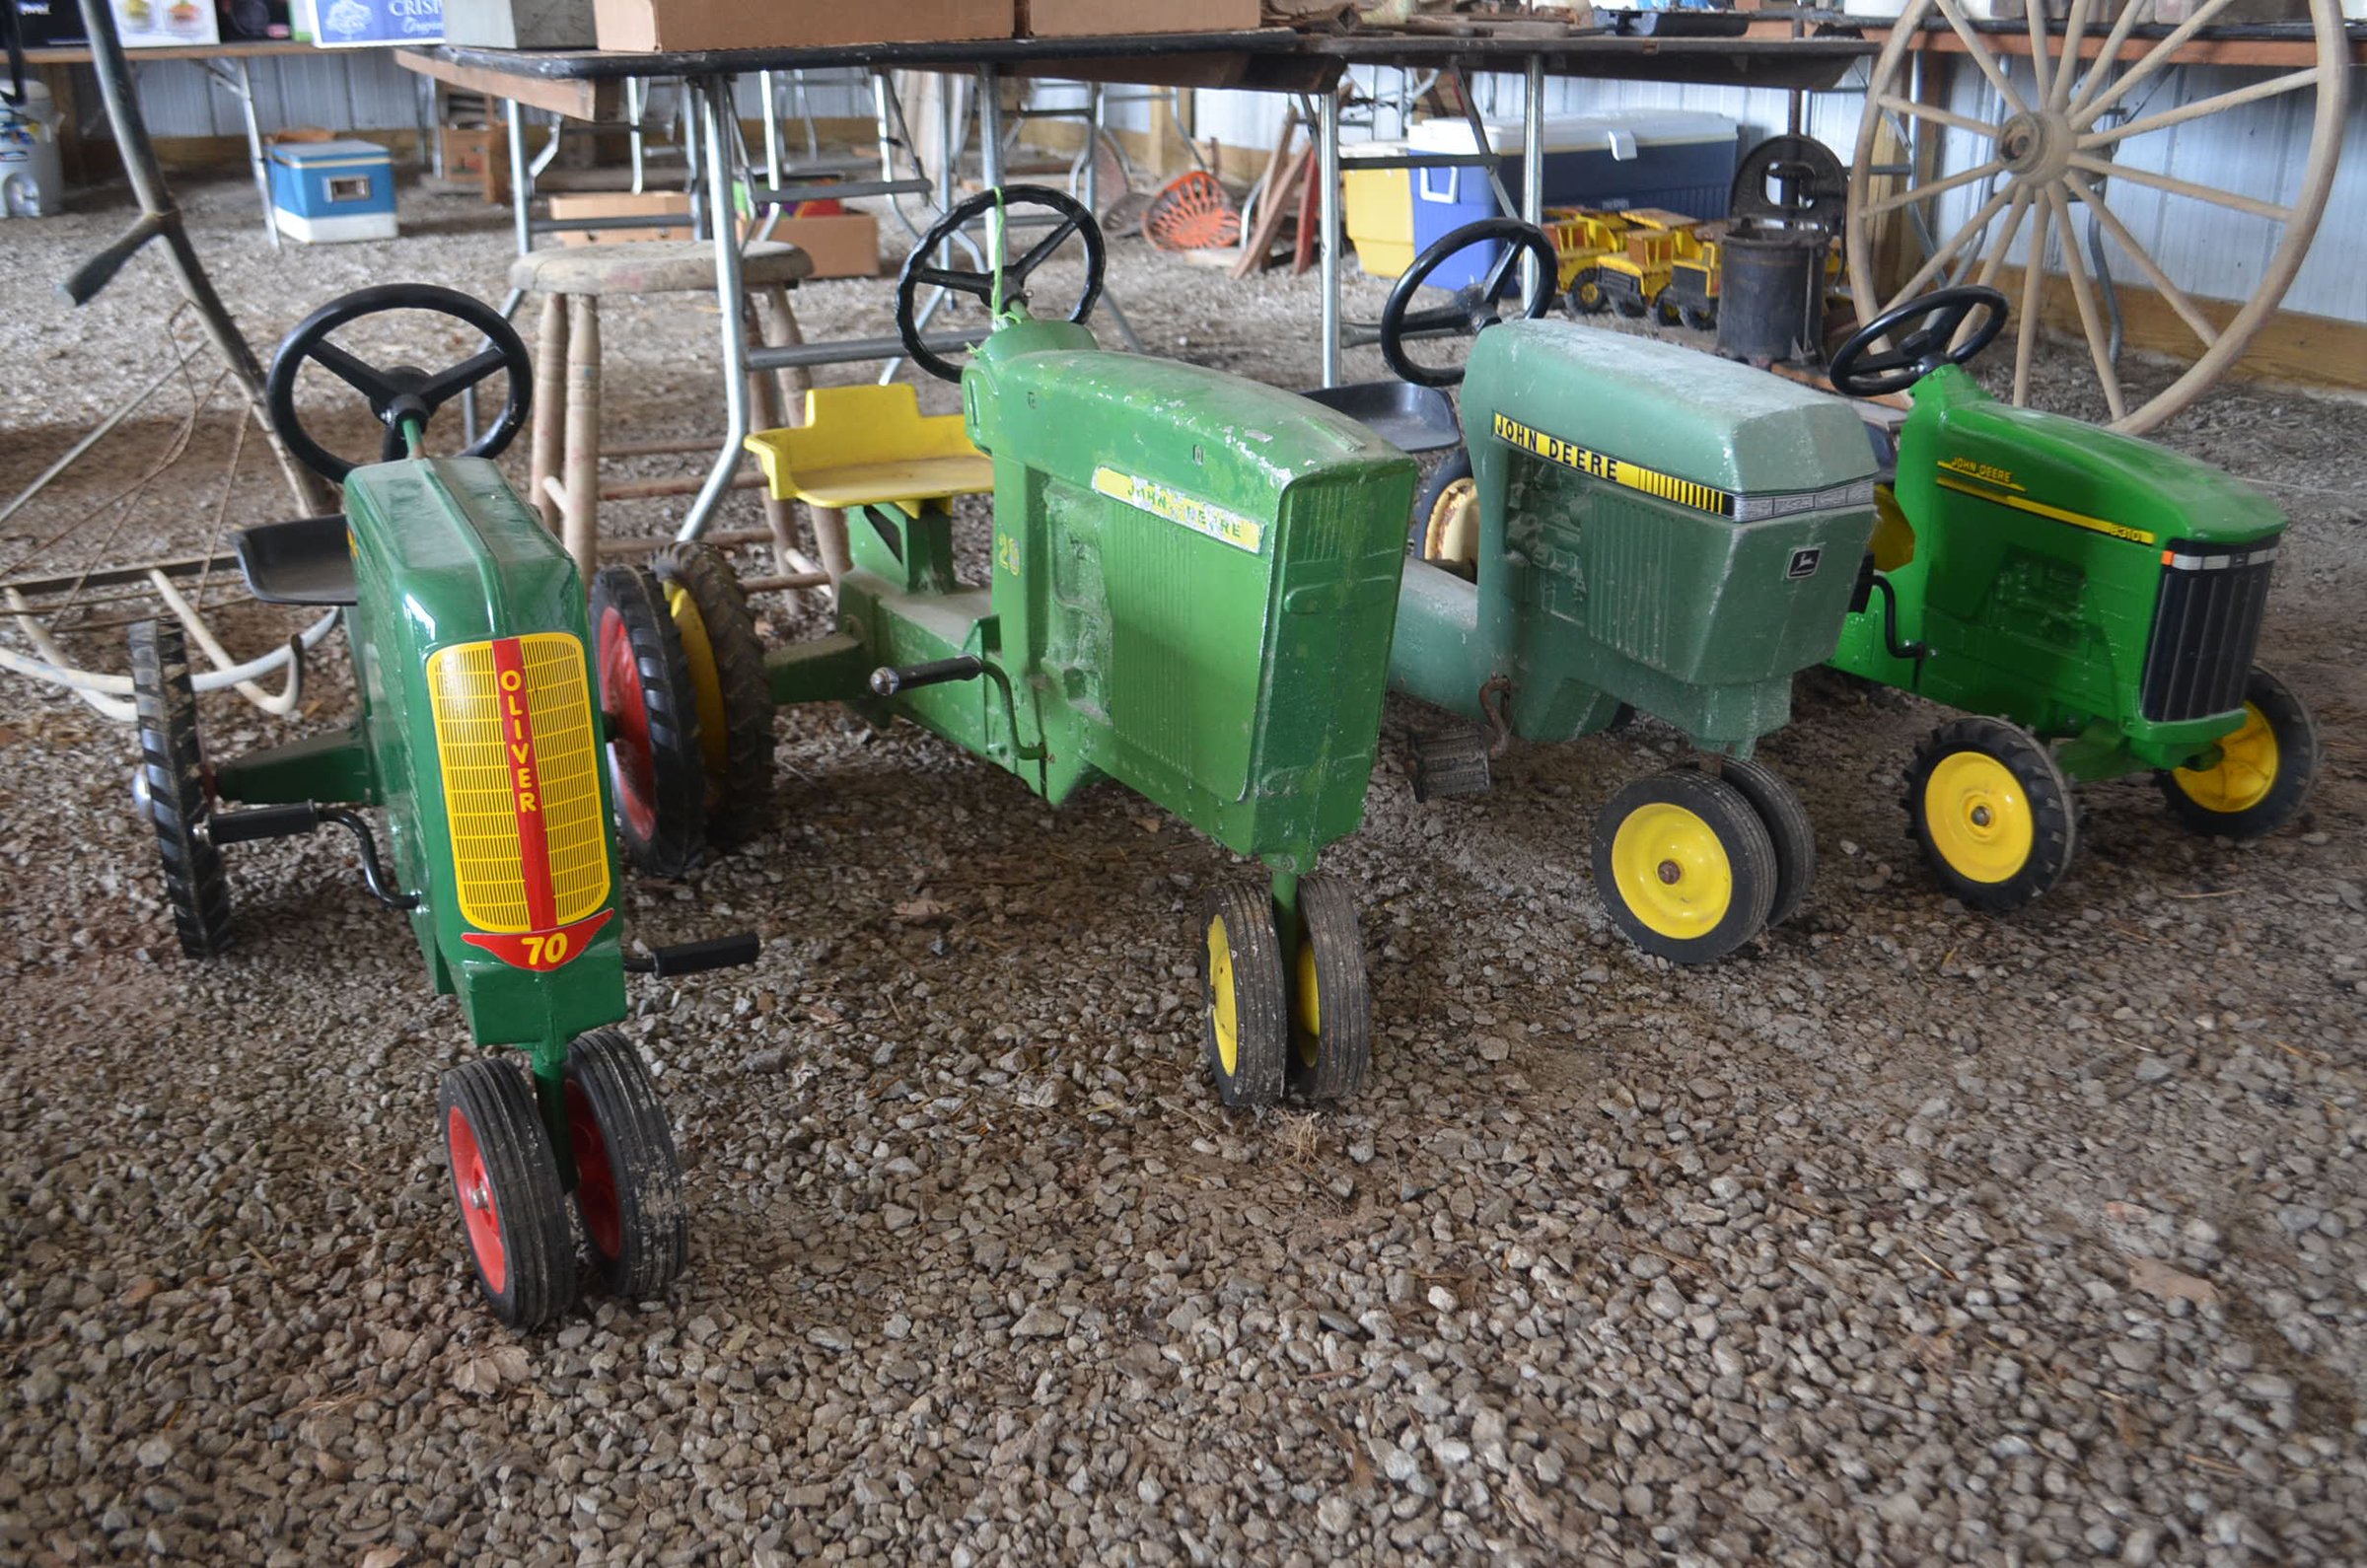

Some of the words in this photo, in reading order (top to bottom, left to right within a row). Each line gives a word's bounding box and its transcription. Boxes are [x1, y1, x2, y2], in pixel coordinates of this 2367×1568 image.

[1495, 418, 1539, 452] JOHN
[1548, 437, 1618, 481] DEERE
[1952, 457, 1976, 472] JOHN
[1978, 464, 2012, 483] DEERE
[1185, 506, 1242, 538] ERE
[500, 669, 538, 814] OLIVER
[521, 931, 569, 966] 70
